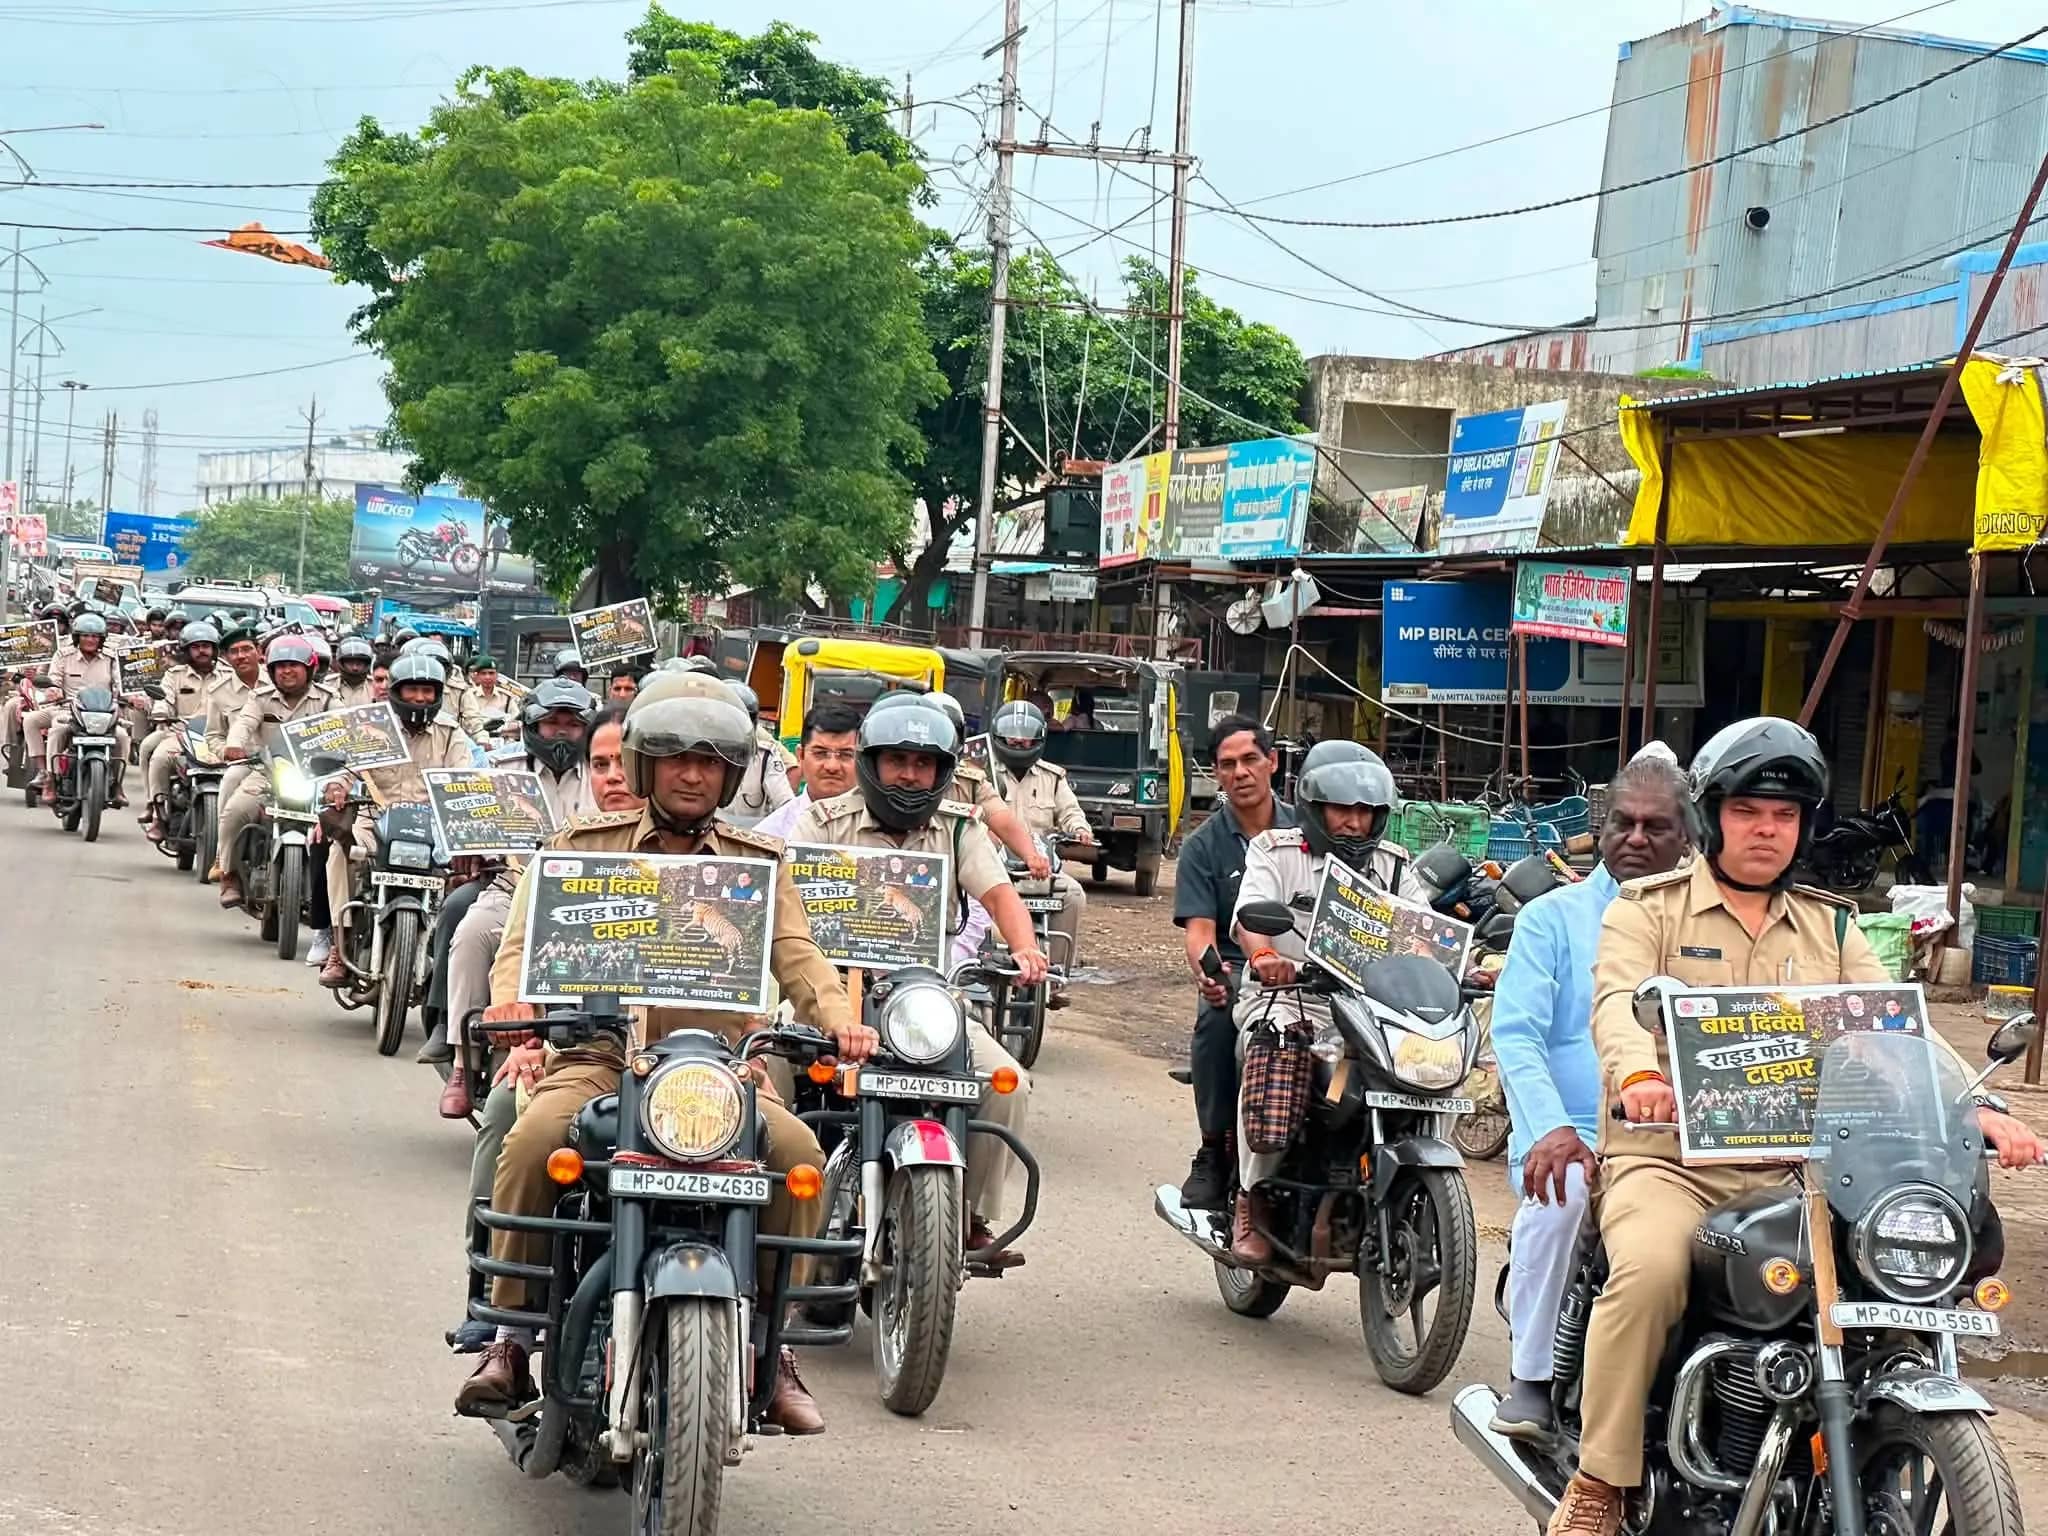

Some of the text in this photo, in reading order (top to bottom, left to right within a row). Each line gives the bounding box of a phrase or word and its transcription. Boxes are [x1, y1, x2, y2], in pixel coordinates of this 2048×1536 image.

[1463, 455, 1481, 473] BIRLA
[1482, 451, 1511, 471] CEMENT
[366, 501, 414, 518] WICKED
[1400, 627, 1425, 641] MP
[1429, 627, 1478, 641] BIRLA
[1482, 627, 1550, 643] CEEN
[1433, 644, 1462, 659] सीमेंट
[1466, 644, 1477, 658] से
[1480, 647, 1496, 659] घर
[1446, 693, 1474, 702] MITTAL
[1532, 694, 1585, 703] ENTERPRISES
[392, 802, 432, 812] POLIC
[818, 864, 857, 879] दिवस
[562, 876, 659, 896] बाघ दिवस
[821, 883, 850, 897] फॉर
[561, 900, 649, 922] राइड फॉर
[806, 899, 858, 914] टाइगर
[1337, 885, 1362, 908] बाघ
[1362, 898, 1393, 924] दिवस
[591, 919, 659, 940] टाइगर
[1335, 905, 1385, 936] राइड फॉर
[1349, 926, 1389, 950] टाइगर
[1698, 1012, 1806, 1035] बाघ दिवस
[1707, 1039, 1801, 1068] राइड फॉर
[1743, 1058, 1816, 1085] टाइगर
[1695, 1226, 1748, 1256] HONDA
